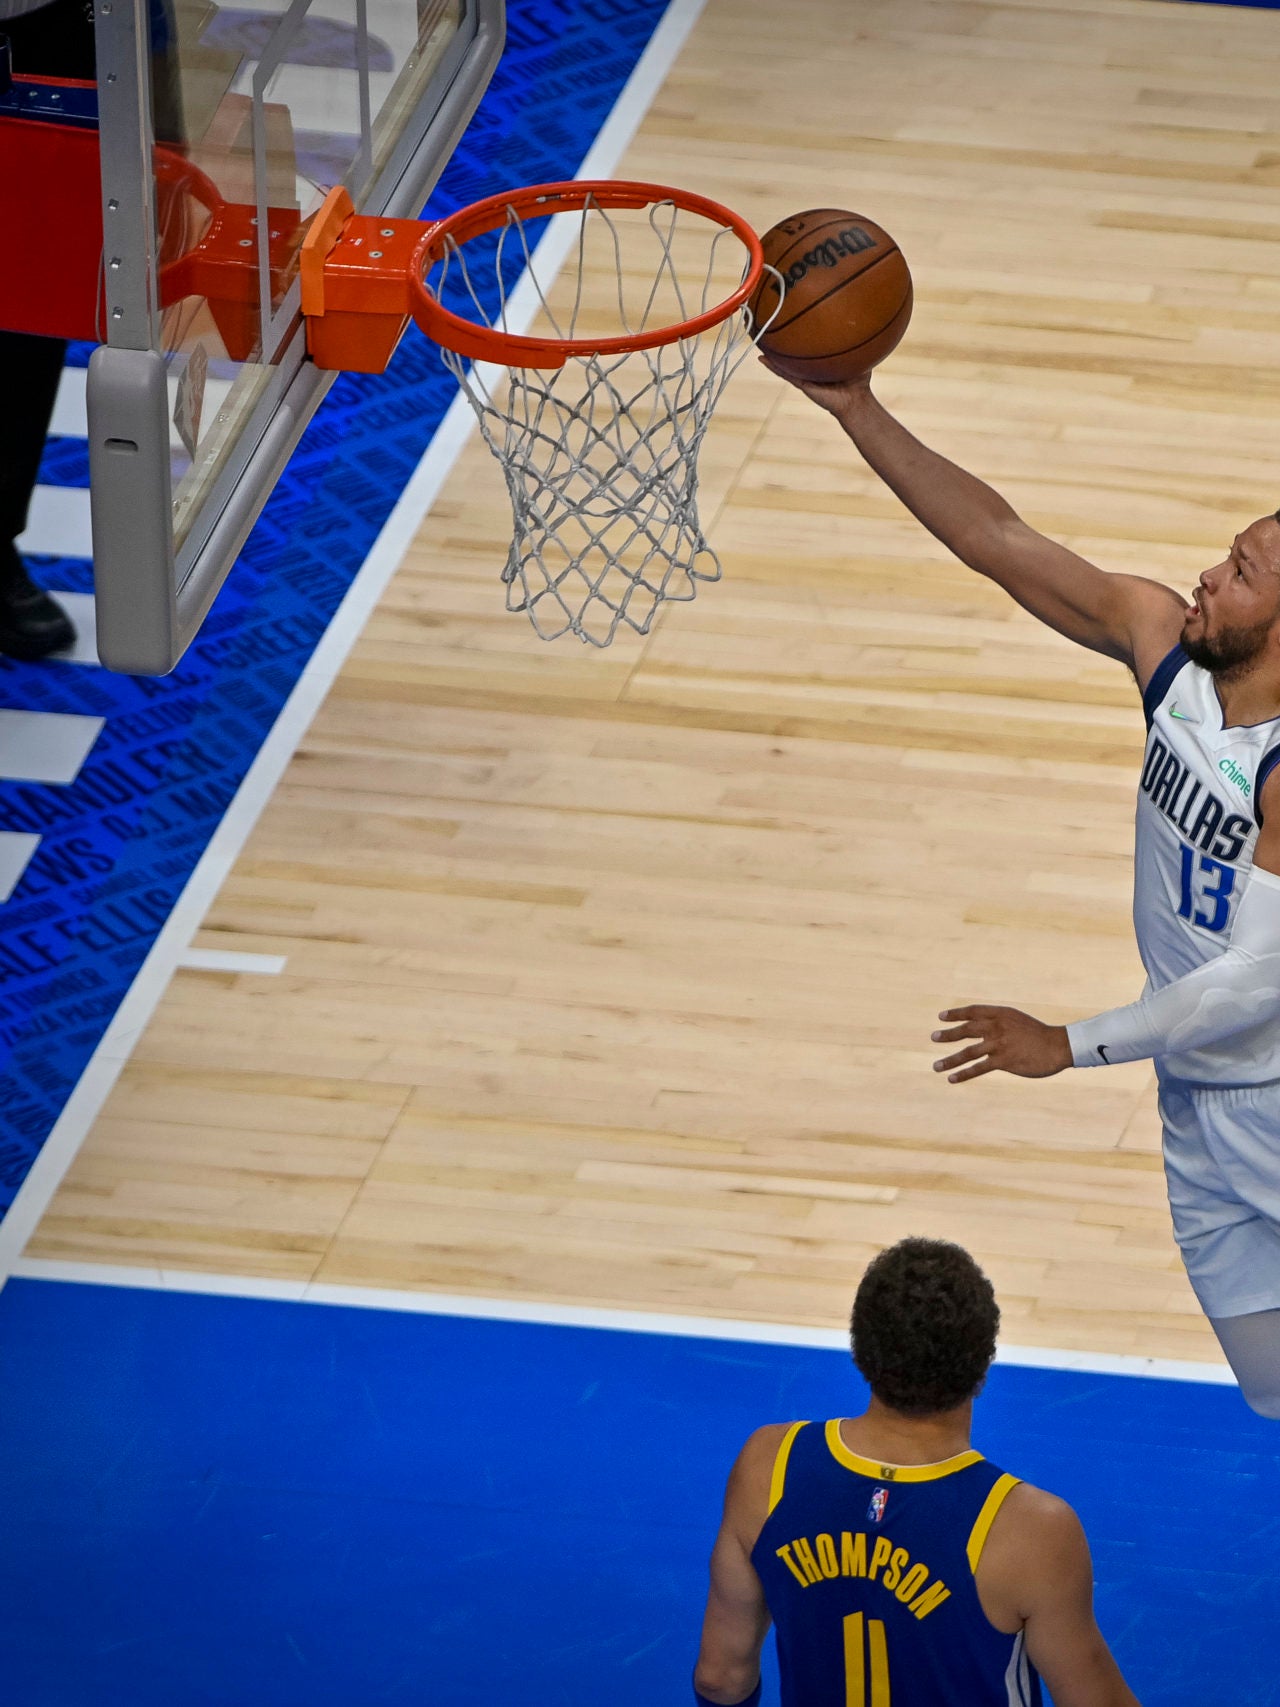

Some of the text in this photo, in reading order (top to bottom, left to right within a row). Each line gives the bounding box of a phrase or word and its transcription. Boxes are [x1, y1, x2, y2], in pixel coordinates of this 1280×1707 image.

[0, 737, 226, 833] HANDLER
[1141, 735, 1254, 862] DALLAS
[1177, 841, 1236, 933] 13
[775, 1531, 951, 1621] THOMPSON
[843, 1610, 891, 1707] 11
